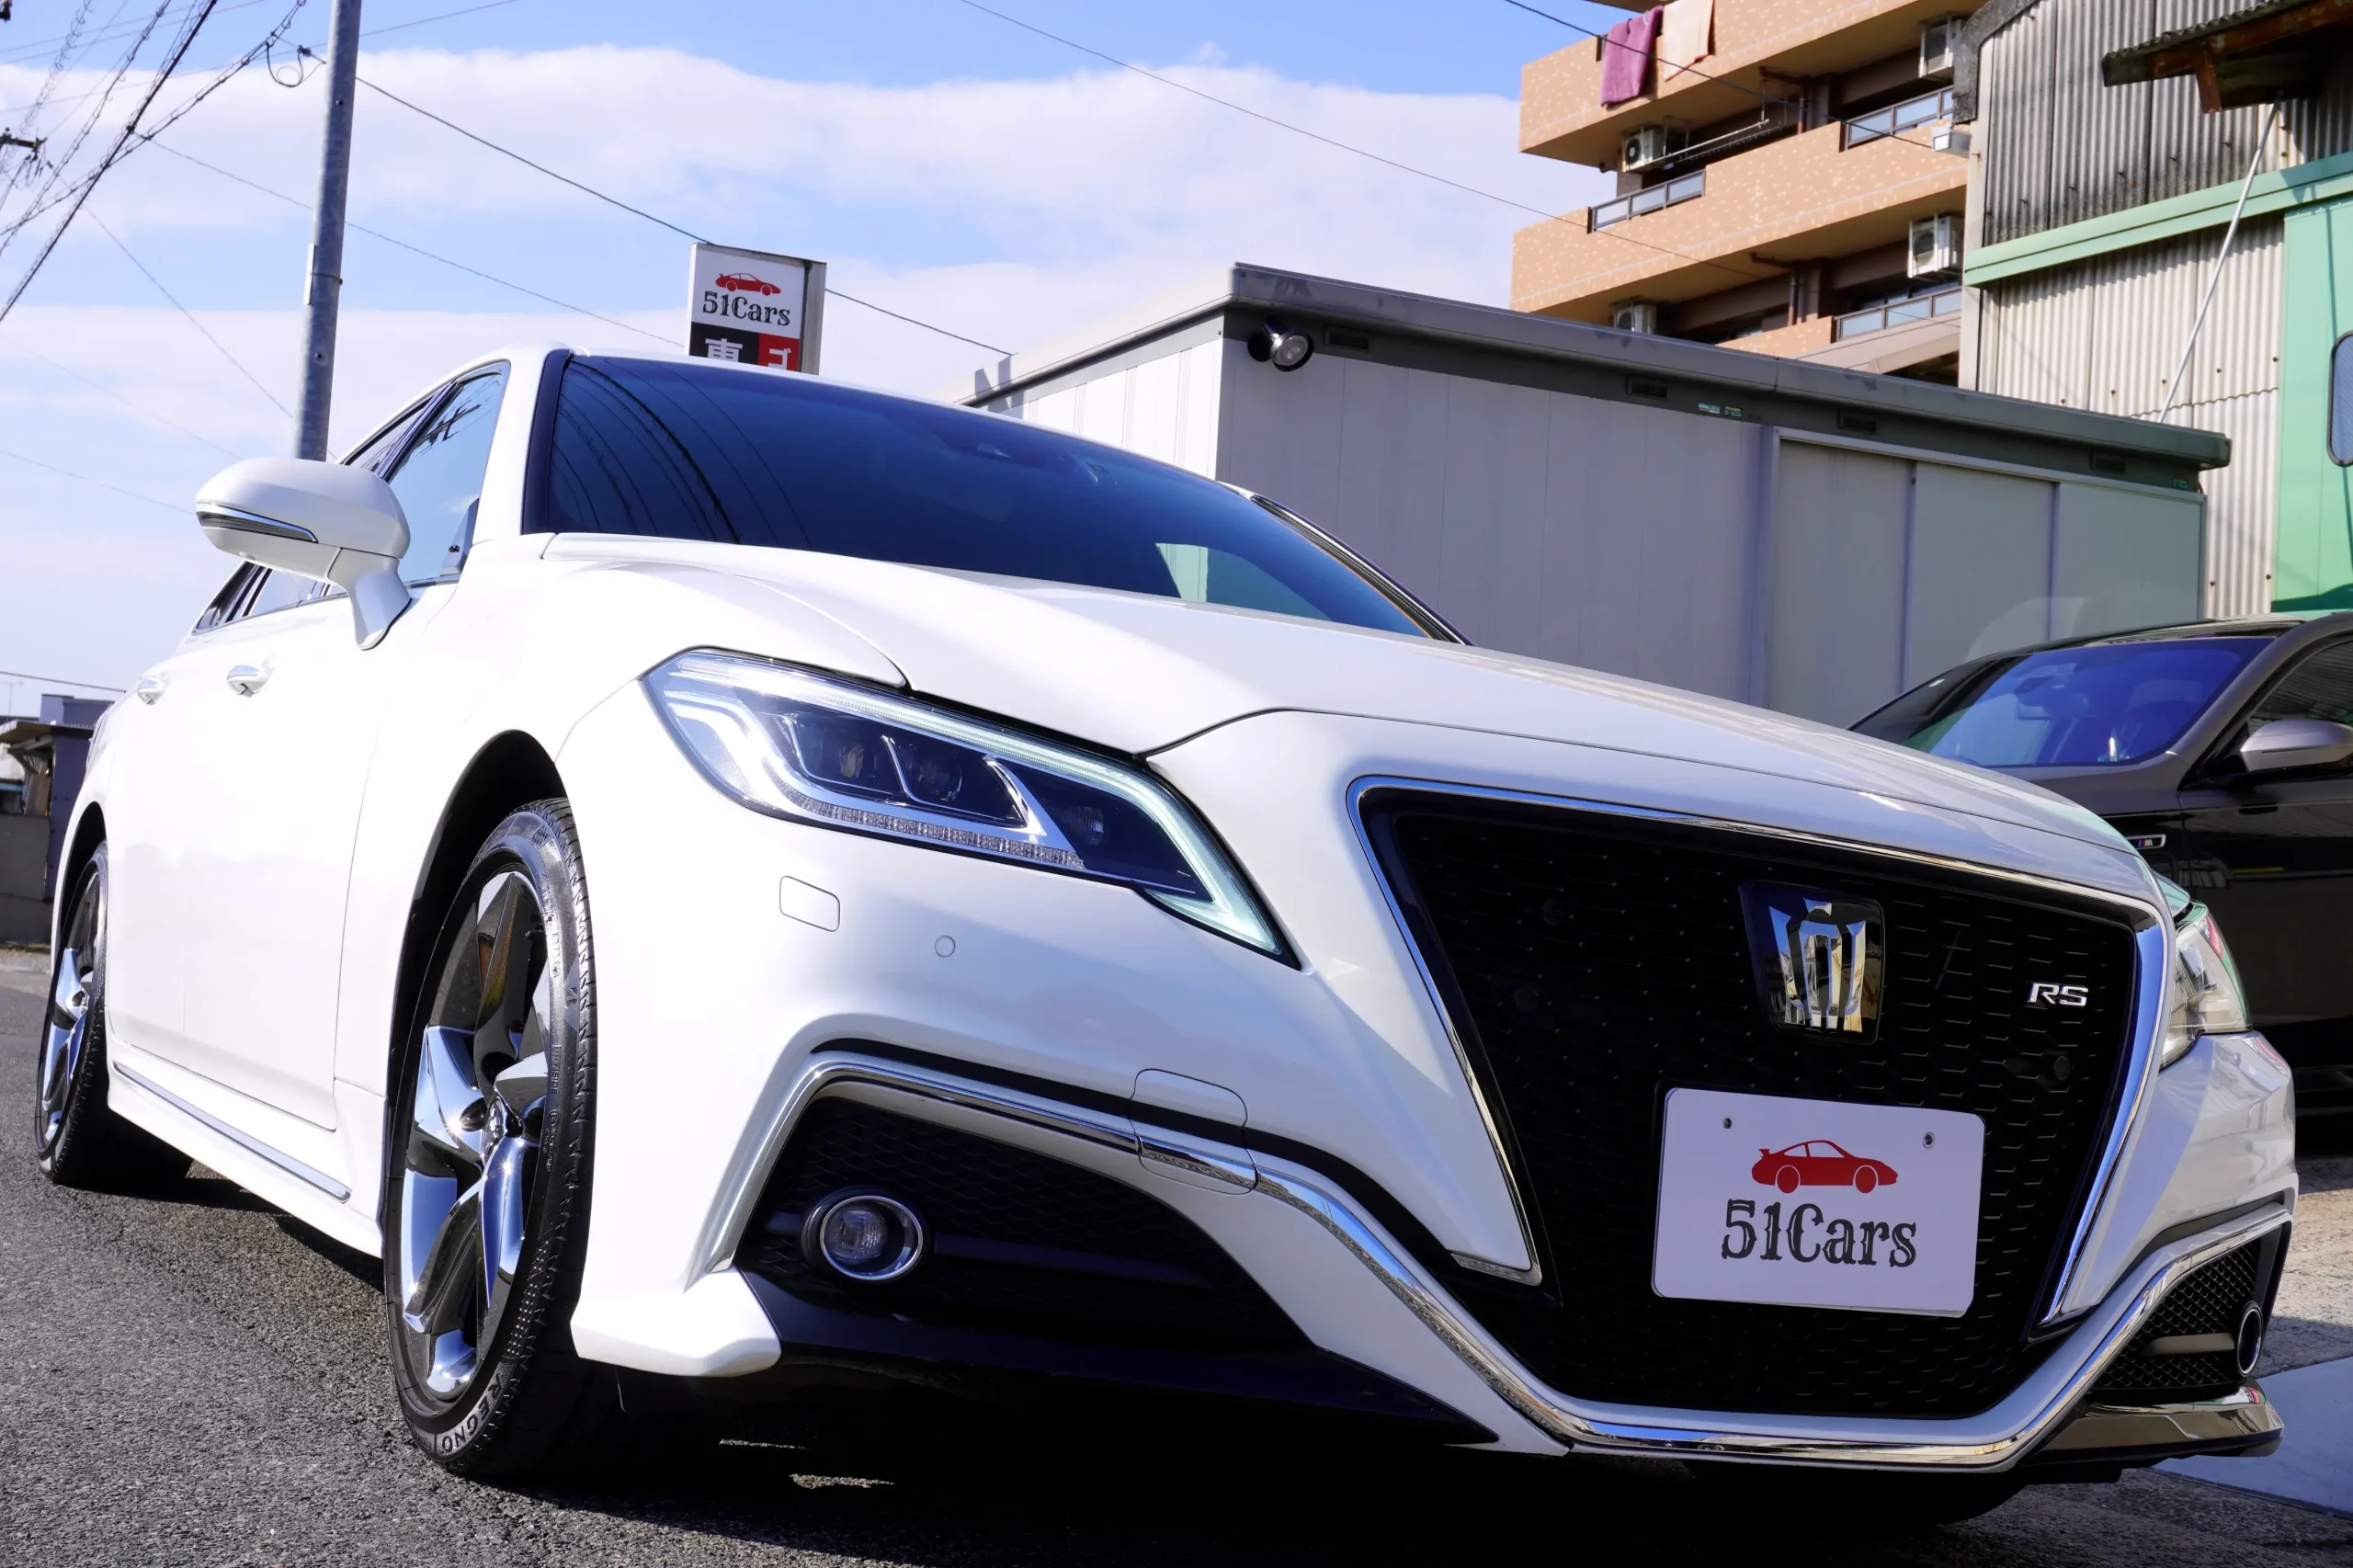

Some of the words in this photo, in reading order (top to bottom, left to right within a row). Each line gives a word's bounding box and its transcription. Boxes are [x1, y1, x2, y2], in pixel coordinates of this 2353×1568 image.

[703, 290, 790, 326] 51Cars
[2027, 983, 2089, 1006] RS
[1721, 1199, 1916, 1267] 51Cars
[441, 1372, 505, 1453] REGNO
